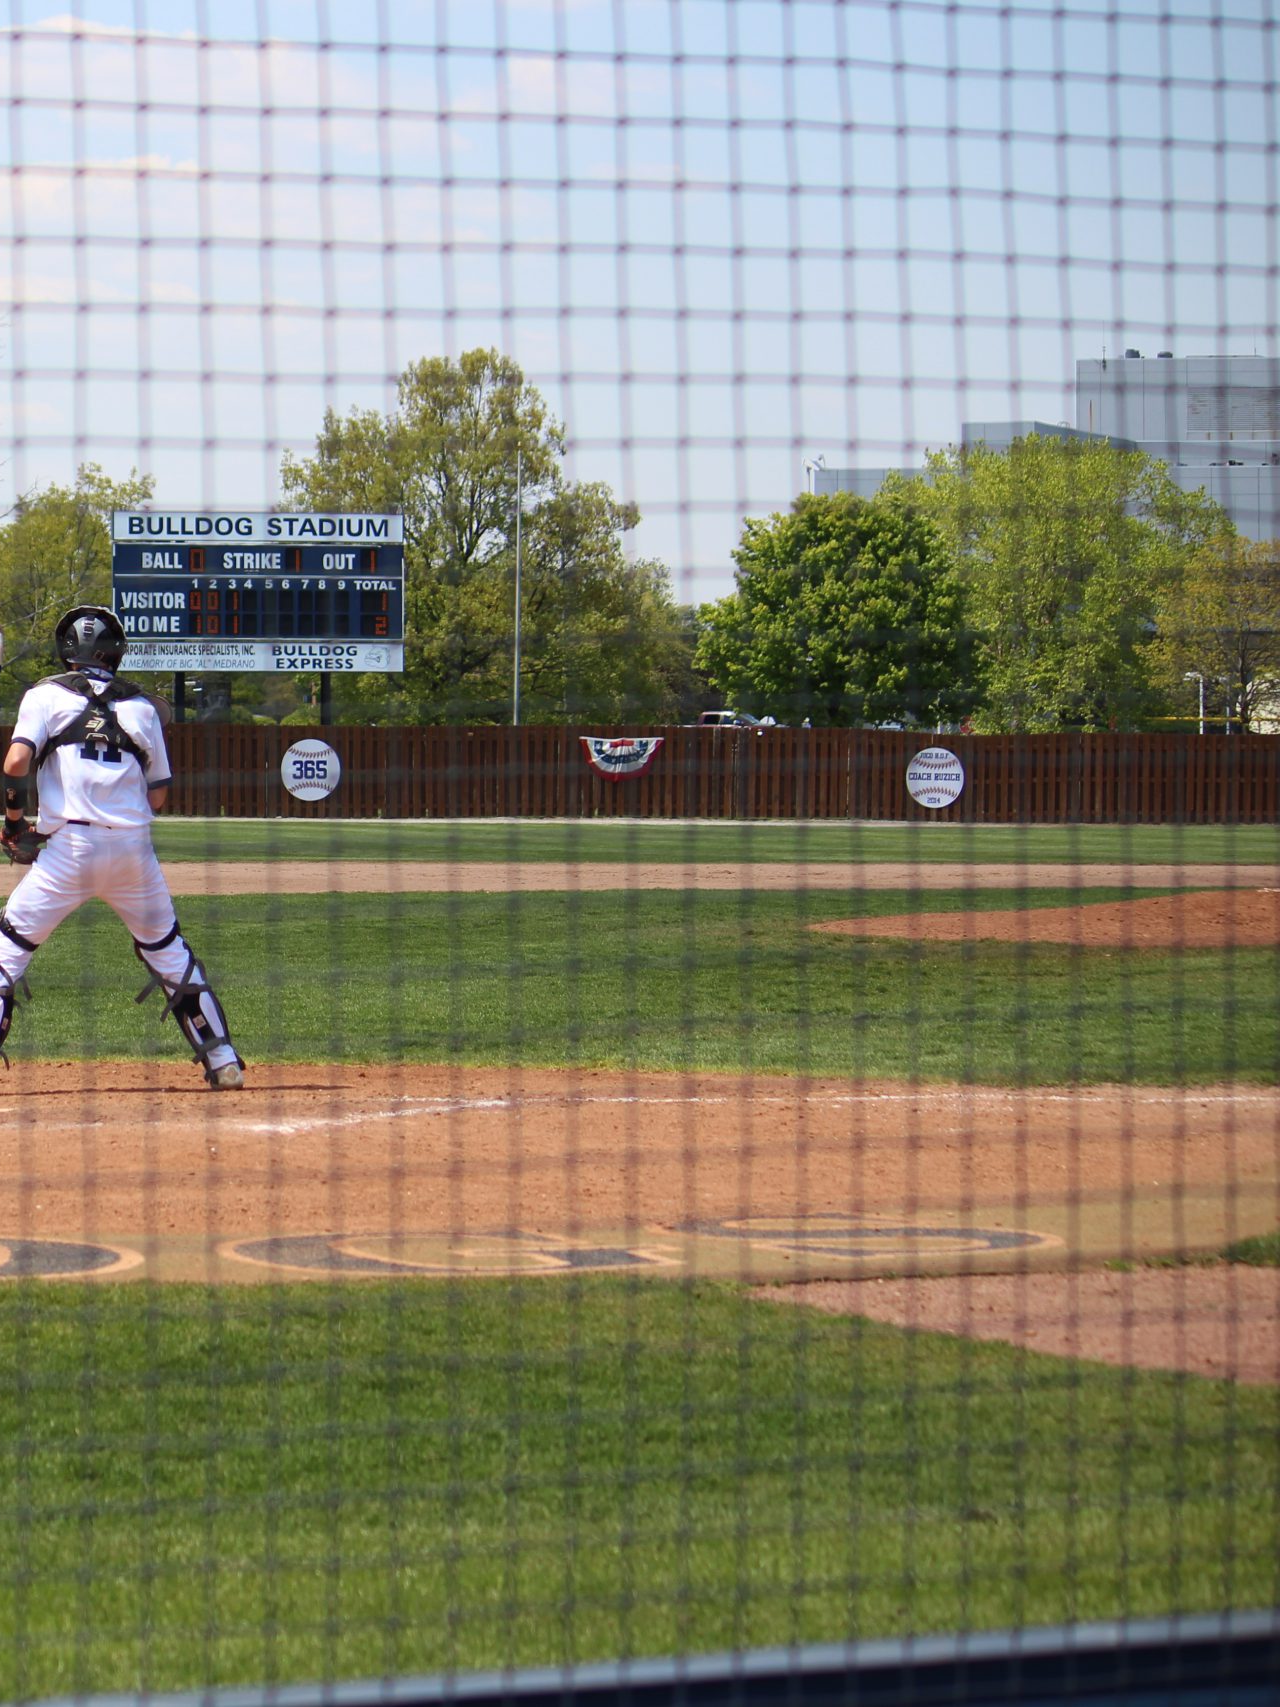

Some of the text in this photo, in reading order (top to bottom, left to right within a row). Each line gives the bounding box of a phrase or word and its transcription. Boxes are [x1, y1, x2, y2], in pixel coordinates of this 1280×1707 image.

[128, 516, 389, 537] BULLDOG STADIUM
[142, 552, 183, 569] BALL
[190, 548, 205, 573] 0
[223, 552, 281, 569] STRIKE
[322, 553, 356, 570] OUT
[192, 578, 397, 591] 1 2 3 4 5 6 7 8 9 TOTAL
[121, 591, 186, 609] VISITOR
[124, 615, 180, 632] HOME
[158, 645, 196, 656] INSURANCE
[241, 645, 256, 656] INC.
[272, 645, 358, 656] BULLDOG
[128, 660, 164, 669] MEMORY
[166, 660, 178, 669] OF
[179, 660, 193, 669] BIG
[213, 660, 255, 669] MEDRANO
[276, 658, 354, 670] EXPRESS
[292, 760, 328, 780] 365
[908, 772, 932, 781] COACH
